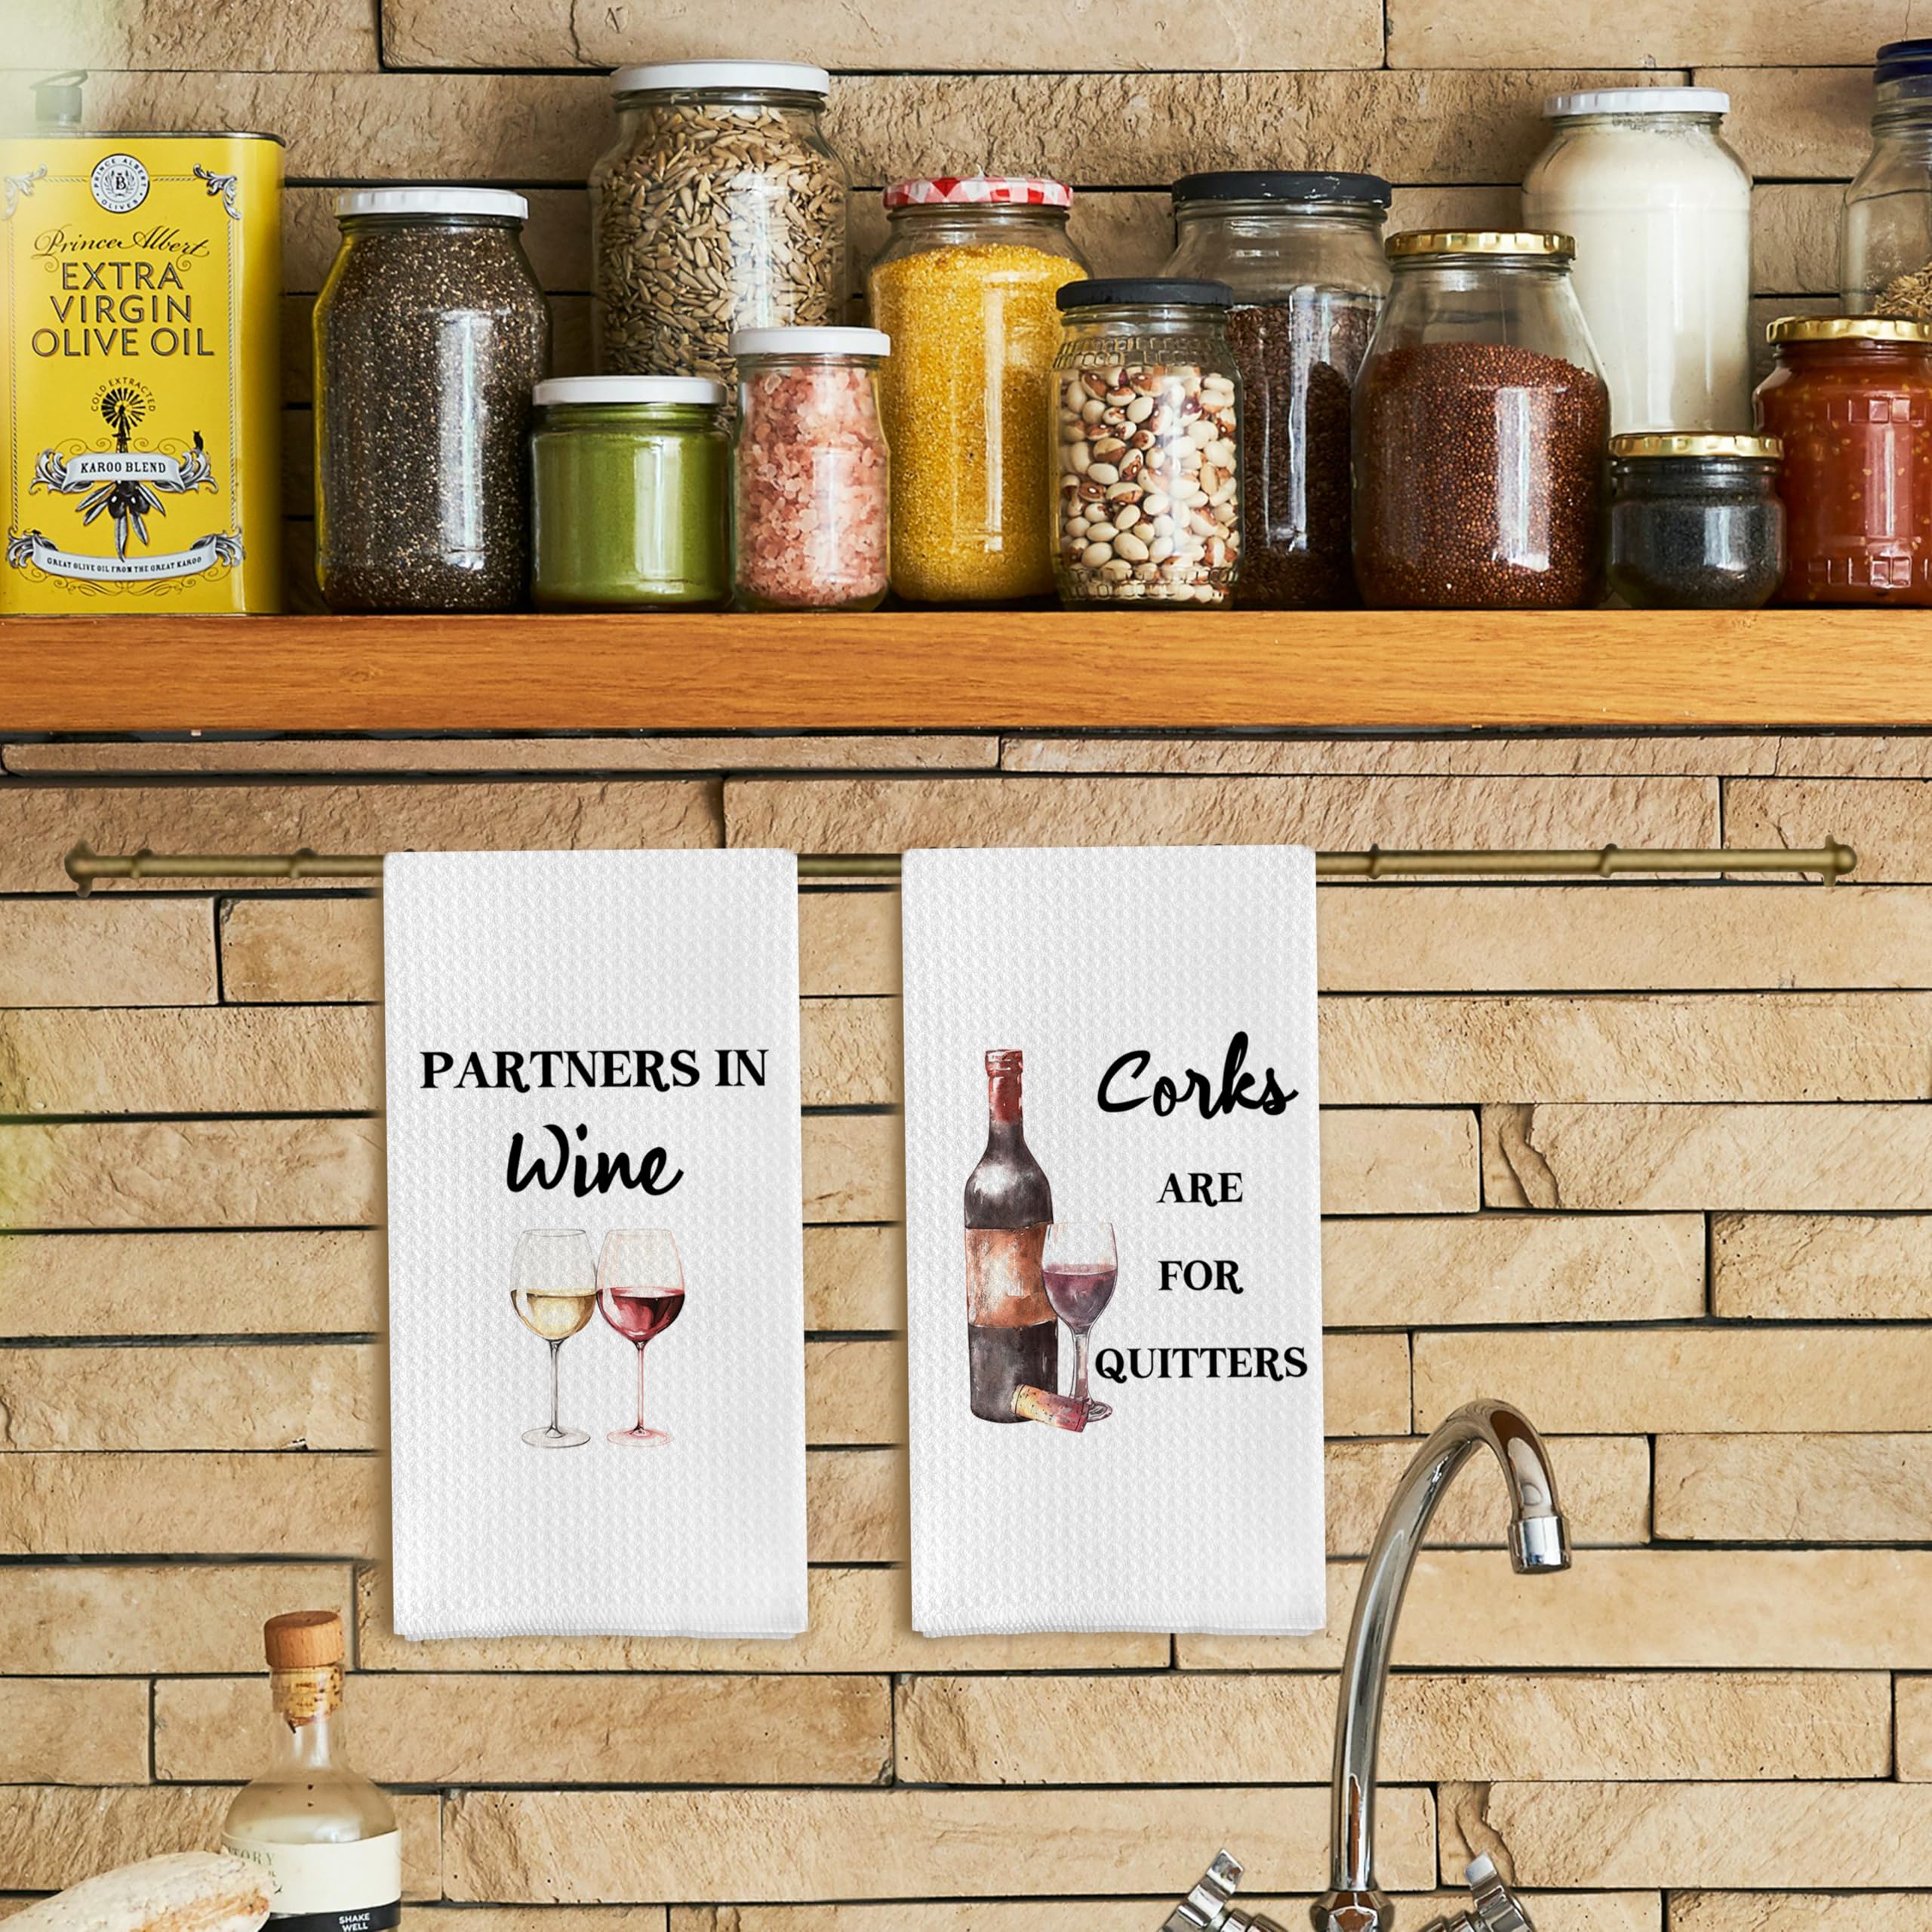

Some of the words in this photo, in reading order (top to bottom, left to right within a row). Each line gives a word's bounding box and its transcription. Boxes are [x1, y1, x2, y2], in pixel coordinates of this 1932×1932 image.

[94, 158, 115, 189] PRINCE
[122, 158, 147, 187] ALBERT
[115, 173, 127, 190] B
[101, 199, 139, 211] OLIVES
[31, 224, 123, 260] Prince
[130, 225, 211, 259] Albert
[62, 262, 183, 291] EXTRA
[50, 295, 192, 323] VIRGIN
[32, 328, 140, 357] OLIVE
[150, 328, 215, 357] OIL
[91, 385, 107, 412] COLD
[108, 377, 156, 412] EXTRACTED
[80, 462, 122, 474] KAROO
[125, 462, 167, 474] BLEND
[47, 557, 72, 569] GREAT
[72, 563, 96, 572] OLIVE
[111, 565, 133, 574] FROM
[150, 562, 175, 572] GREAT
[177, 556, 203, 568] KAROO
[420, 1049, 700, 1094] PARTNERS
[714, 1049, 769, 1087] IN
[1097, 1031, 1300, 1120] Corks
[506, 1123, 685, 1198] Wine
[1156, 1172, 1244, 1208] ARE
[1158, 1260, 1244, 1294] FOR
[1094, 1346, 1309, 1384] QUITTERS
[339, 1912, 371, 1924] SHAKE
[342, 1922, 368, 1932] WELL
